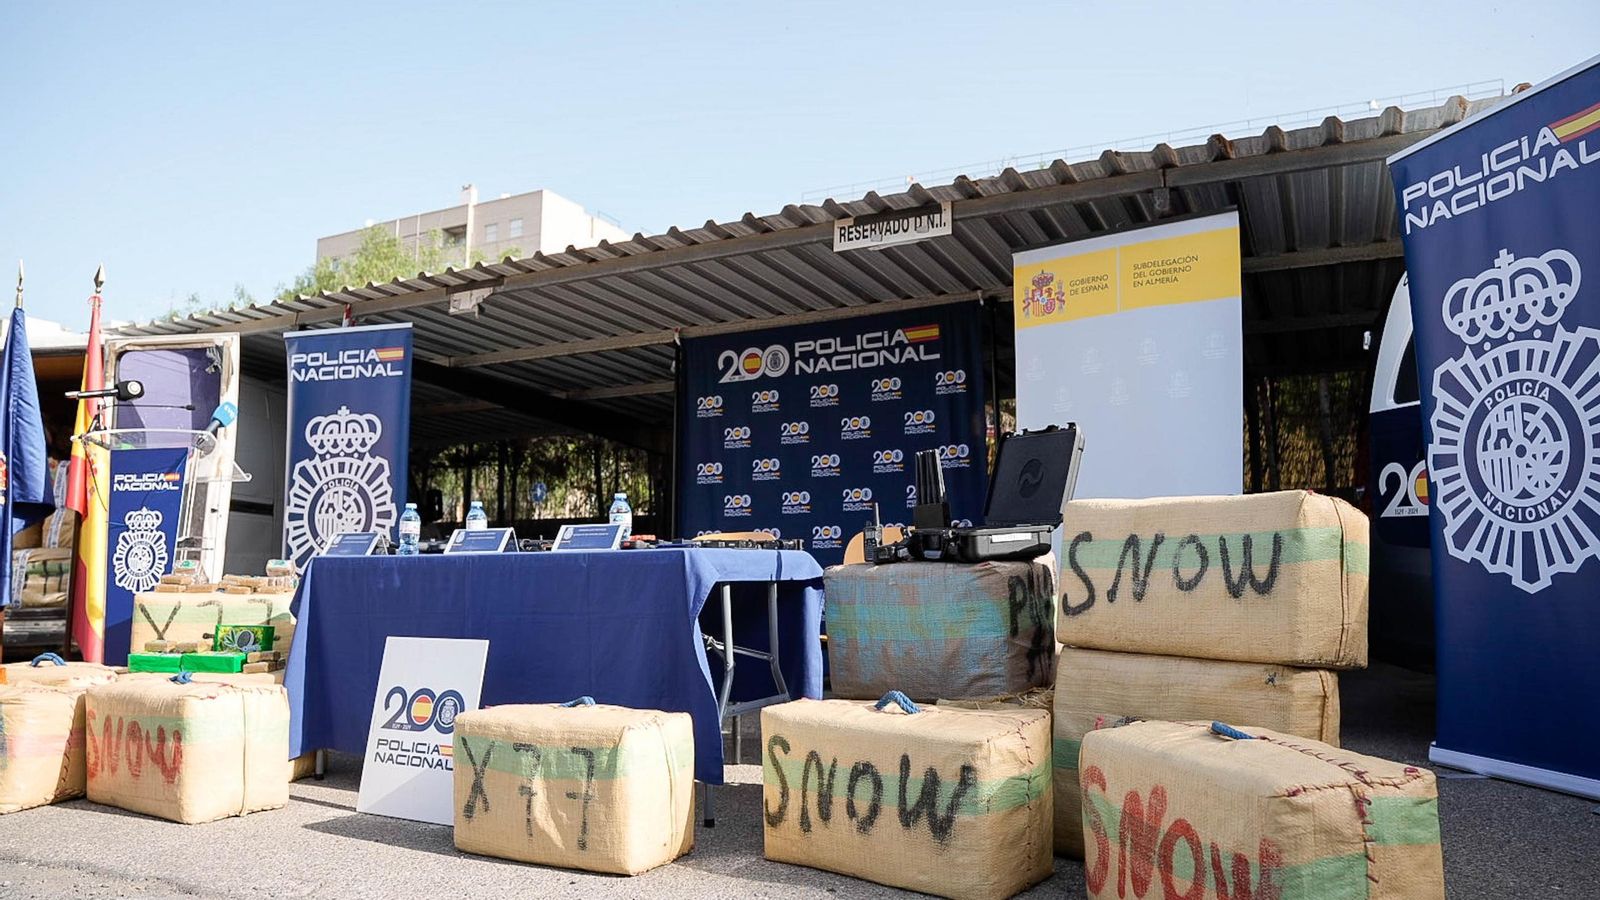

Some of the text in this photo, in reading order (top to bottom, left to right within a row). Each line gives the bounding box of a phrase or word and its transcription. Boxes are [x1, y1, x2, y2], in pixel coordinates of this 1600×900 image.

[1405, 140, 1600, 234] NACIONAL
[839, 219, 910, 243] RESERVADO
[1133, 265, 1192, 279] DEL GOBIERNO
[1069, 274, 1109, 288] GOBIERNO
[1133, 280, 1144, 288] EN
[717, 344, 790, 384] 200
[794, 345, 941, 375] NACIONAL
[290, 362, 403, 382] NACIONAL
[935, 369, 966, 386] 200
[810, 384, 839, 399] 200
[871, 377, 901, 393] 200
[697, 395, 723, 410] 200
[752, 390, 779, 404] 200
[841, 416, 871, 431] 200
[904, 410, 935, 425] 200
[724, 426, 751, 440] 200
[781, 421, 809, 436] 200
[811, 454, 840, 468] 200
[873, 449, 903, 465] 200
[697, 462, 723, 476] 200
[752, 458, 780, 472] 200
[113, 482, 179, 491] NACIONAL
[724, 494, 751, 508] 200
[782, 491, 811, 505] 200
[842, 487, 872, 503] 200
[1483, 488, 1571, 521] NACIONAL
[812, 525, 842, 540] 200
[1062, 531, 1285, 616] SNOW
[380, 685, 466, 735] 200
[86, 708, 183, 784] SNOW
[374, 751, 454, 771] NACIONAL
[764, 734, 978, 848] SNOW
[1082, 765, 1283, 900] SNOW
